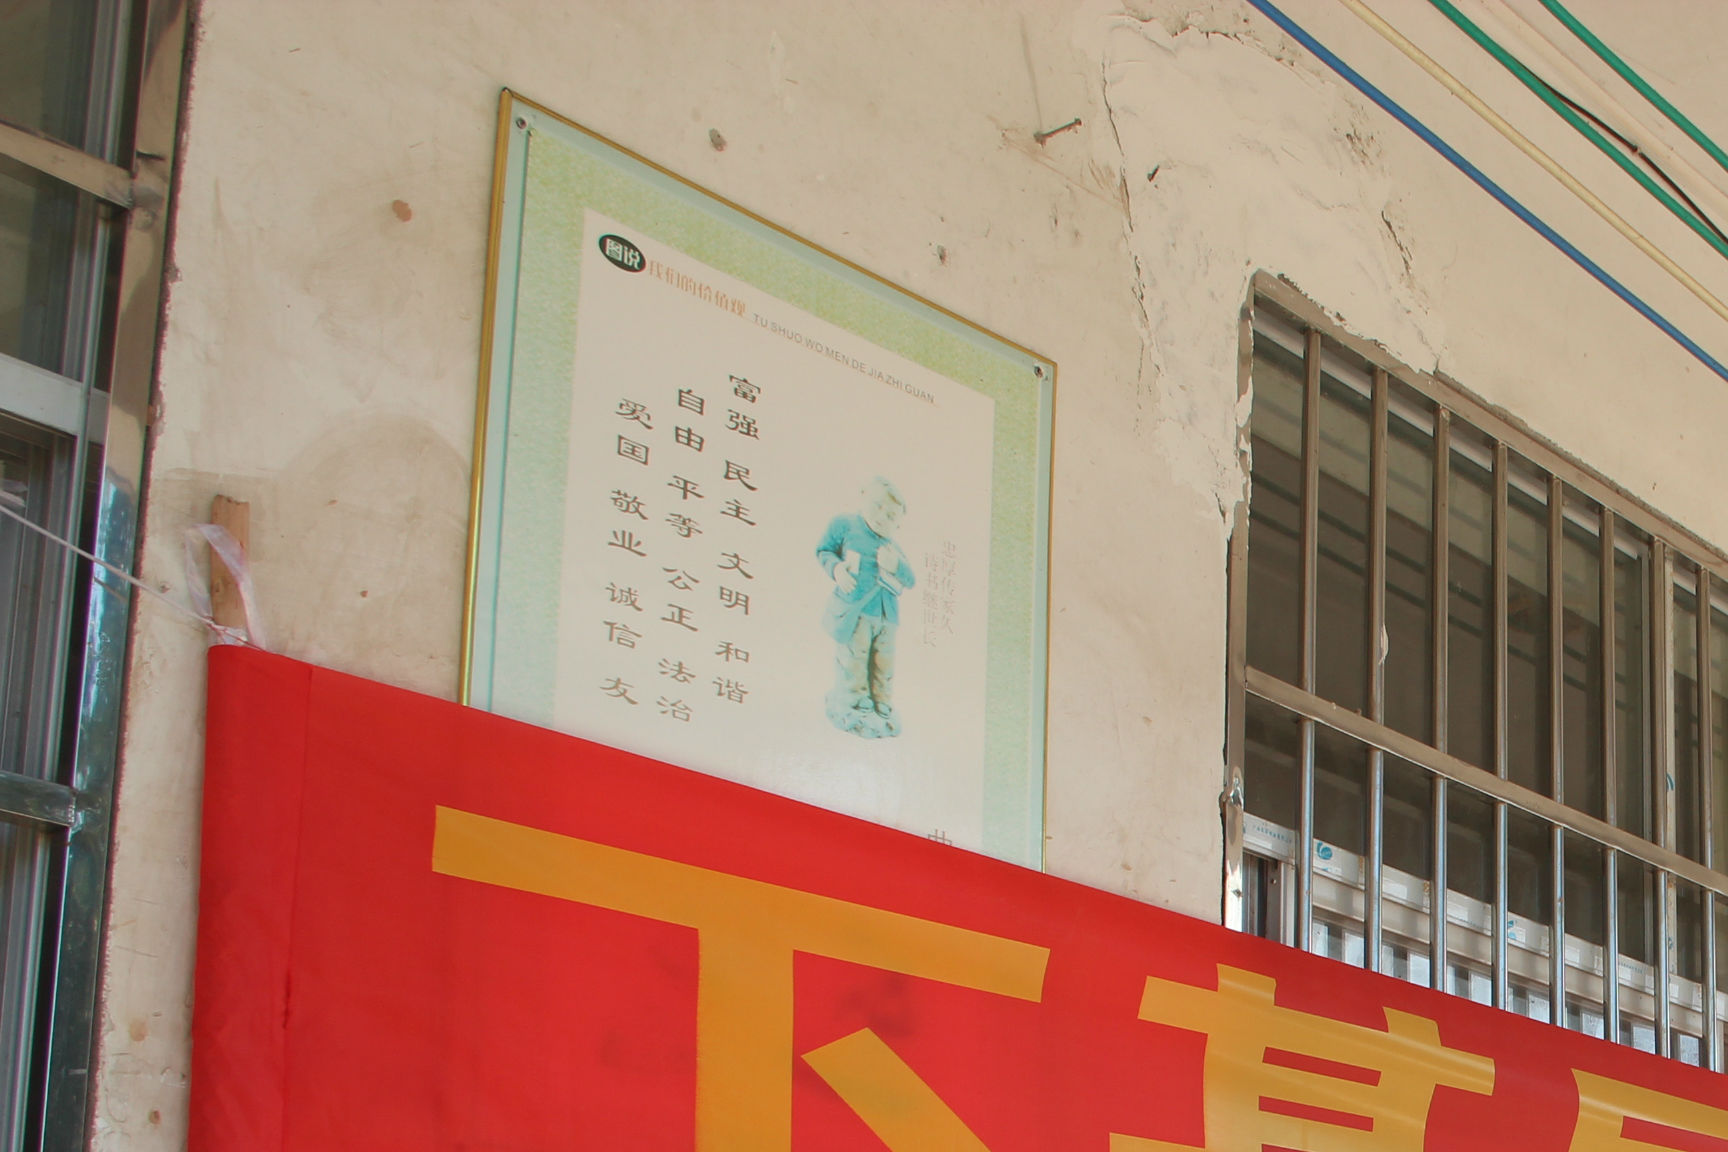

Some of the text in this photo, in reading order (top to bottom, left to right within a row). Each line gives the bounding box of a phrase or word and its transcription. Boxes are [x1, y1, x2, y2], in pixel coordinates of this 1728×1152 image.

[605, 237, 746, 317] 图说 我们的价值观
[753, 313, 935, 404] TU SHUO WO MEN DE JIA ZHI GUAN
[615, 397, 654, 467] 爱国
[607, 489, 649, 558] 敬业
[656, 387, 705, 723] 自由 平等 公正 法治
[712, 374, 761, 705] 富强 民主 文明 和谐
[602, 581, 644, 650] 诚信
